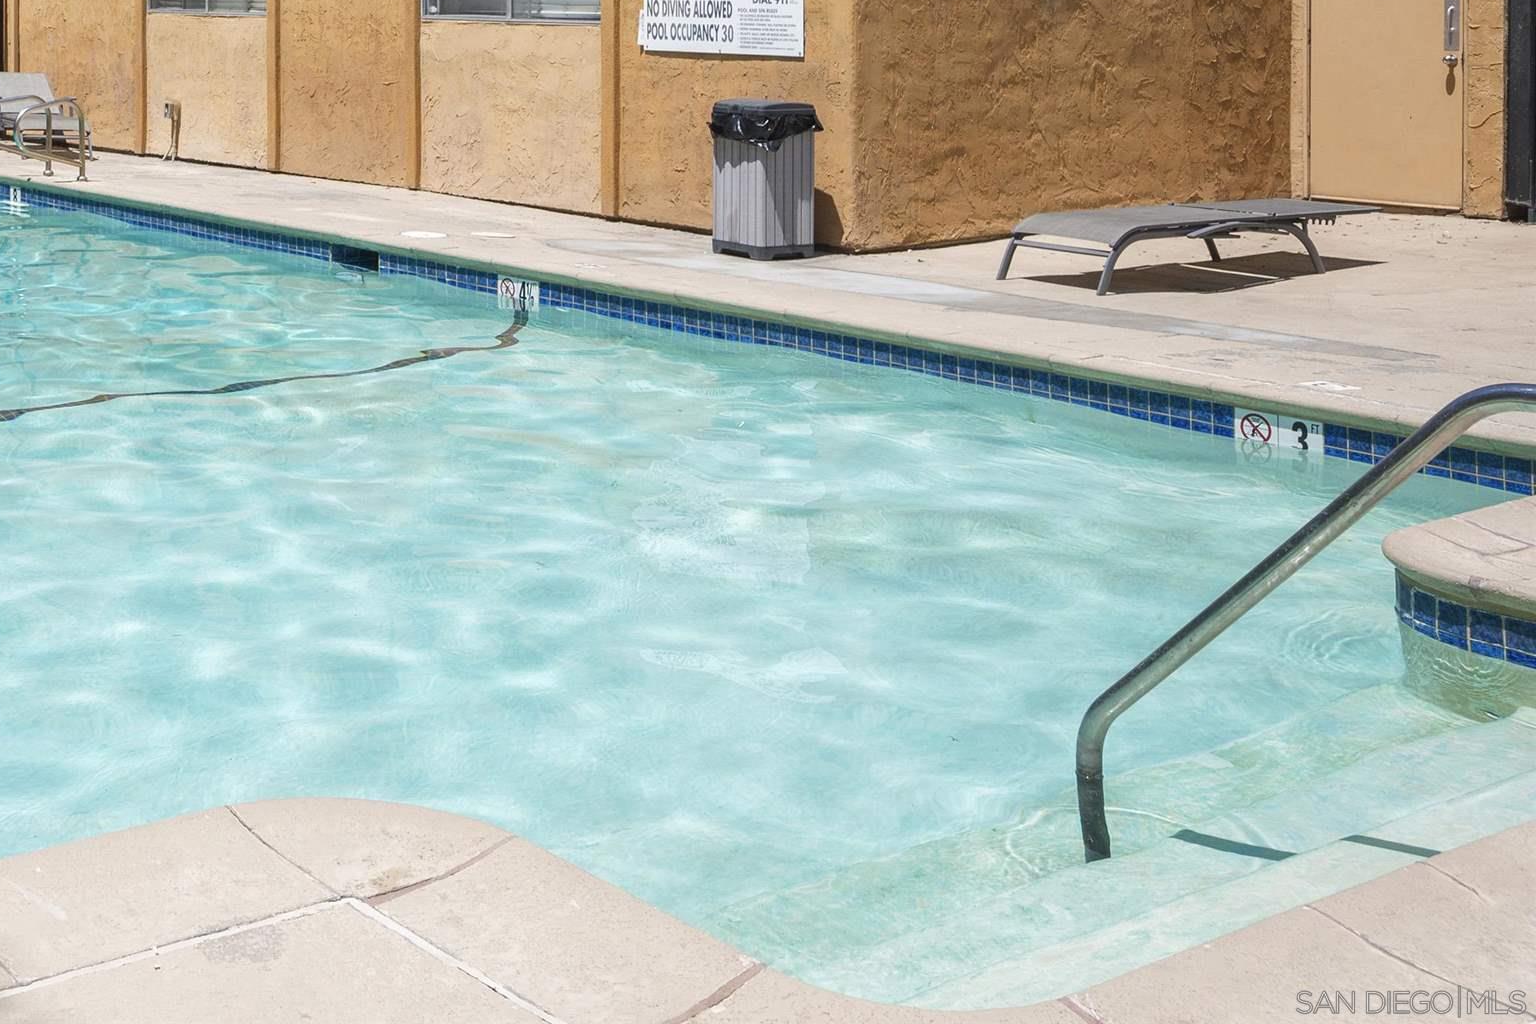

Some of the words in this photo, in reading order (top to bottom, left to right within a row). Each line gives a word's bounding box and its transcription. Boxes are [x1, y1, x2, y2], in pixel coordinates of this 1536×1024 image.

[646, 0, 660, 17] NO
[661, 0, 691, 18] DIVING
[693, 0, 733, 18] ALLOWED
[646, 22, 668, 40] POOL
[670, 22, 720, 42] OCCUPANCY
[721, 24, 734, 43] 30
[1292, 422, 1308, 450] 3
[1311, 424, 1320, 434] FT
